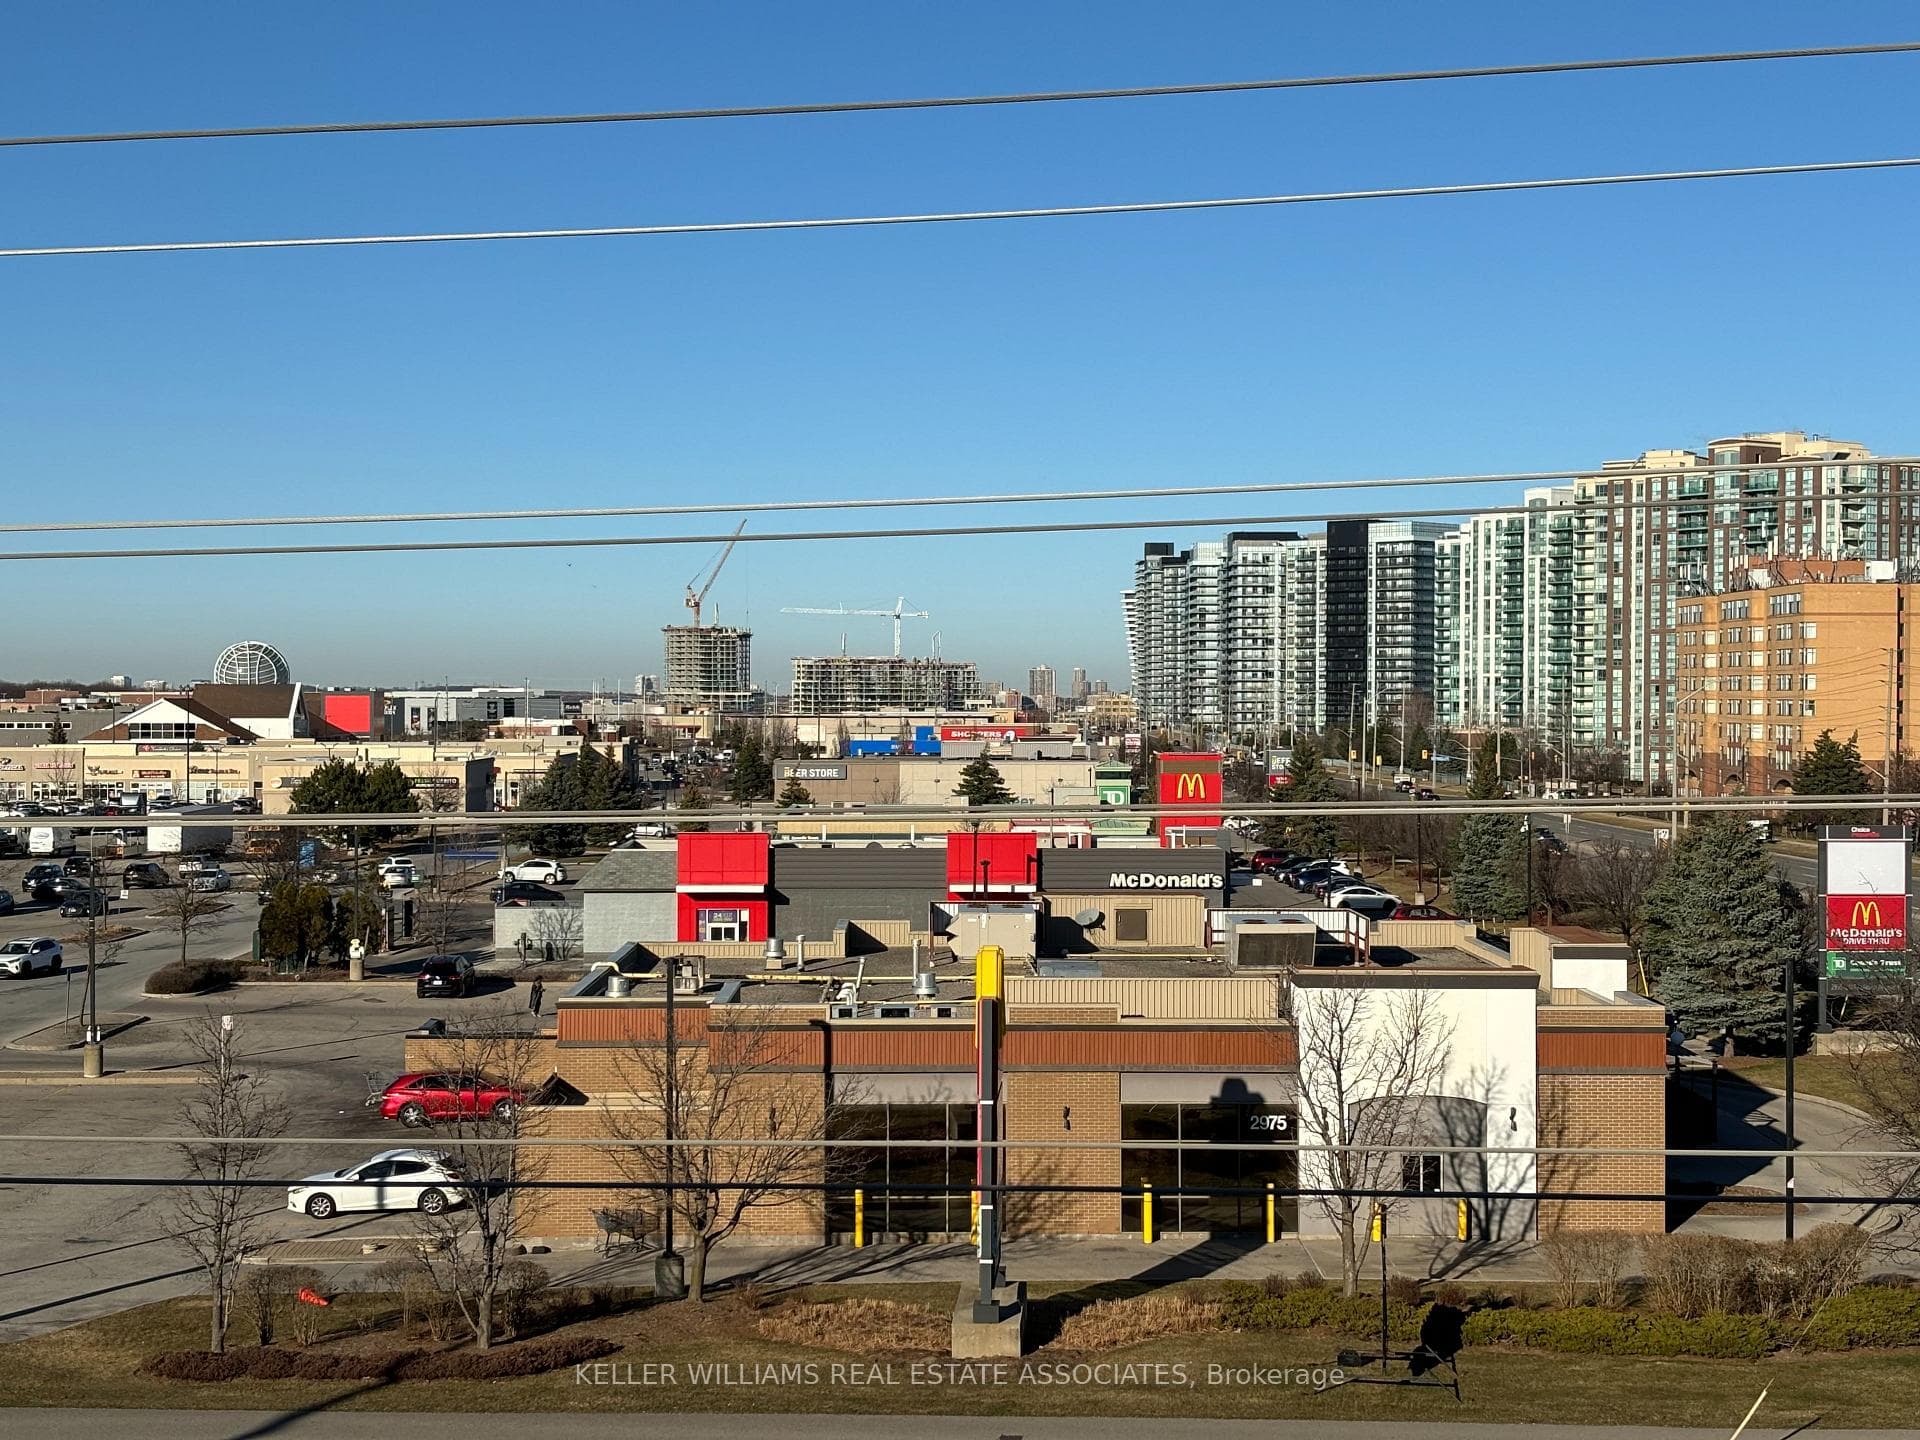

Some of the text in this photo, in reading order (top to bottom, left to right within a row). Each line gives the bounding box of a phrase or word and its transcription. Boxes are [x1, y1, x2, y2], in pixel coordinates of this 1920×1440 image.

[784, 767, 839, 778] BEER STORE
[1109, 873, 1224, 888] McDonald's
[1830, 928, 1903, 938] McDonald's
[1250, 1115, 1288, 1131] 2975
